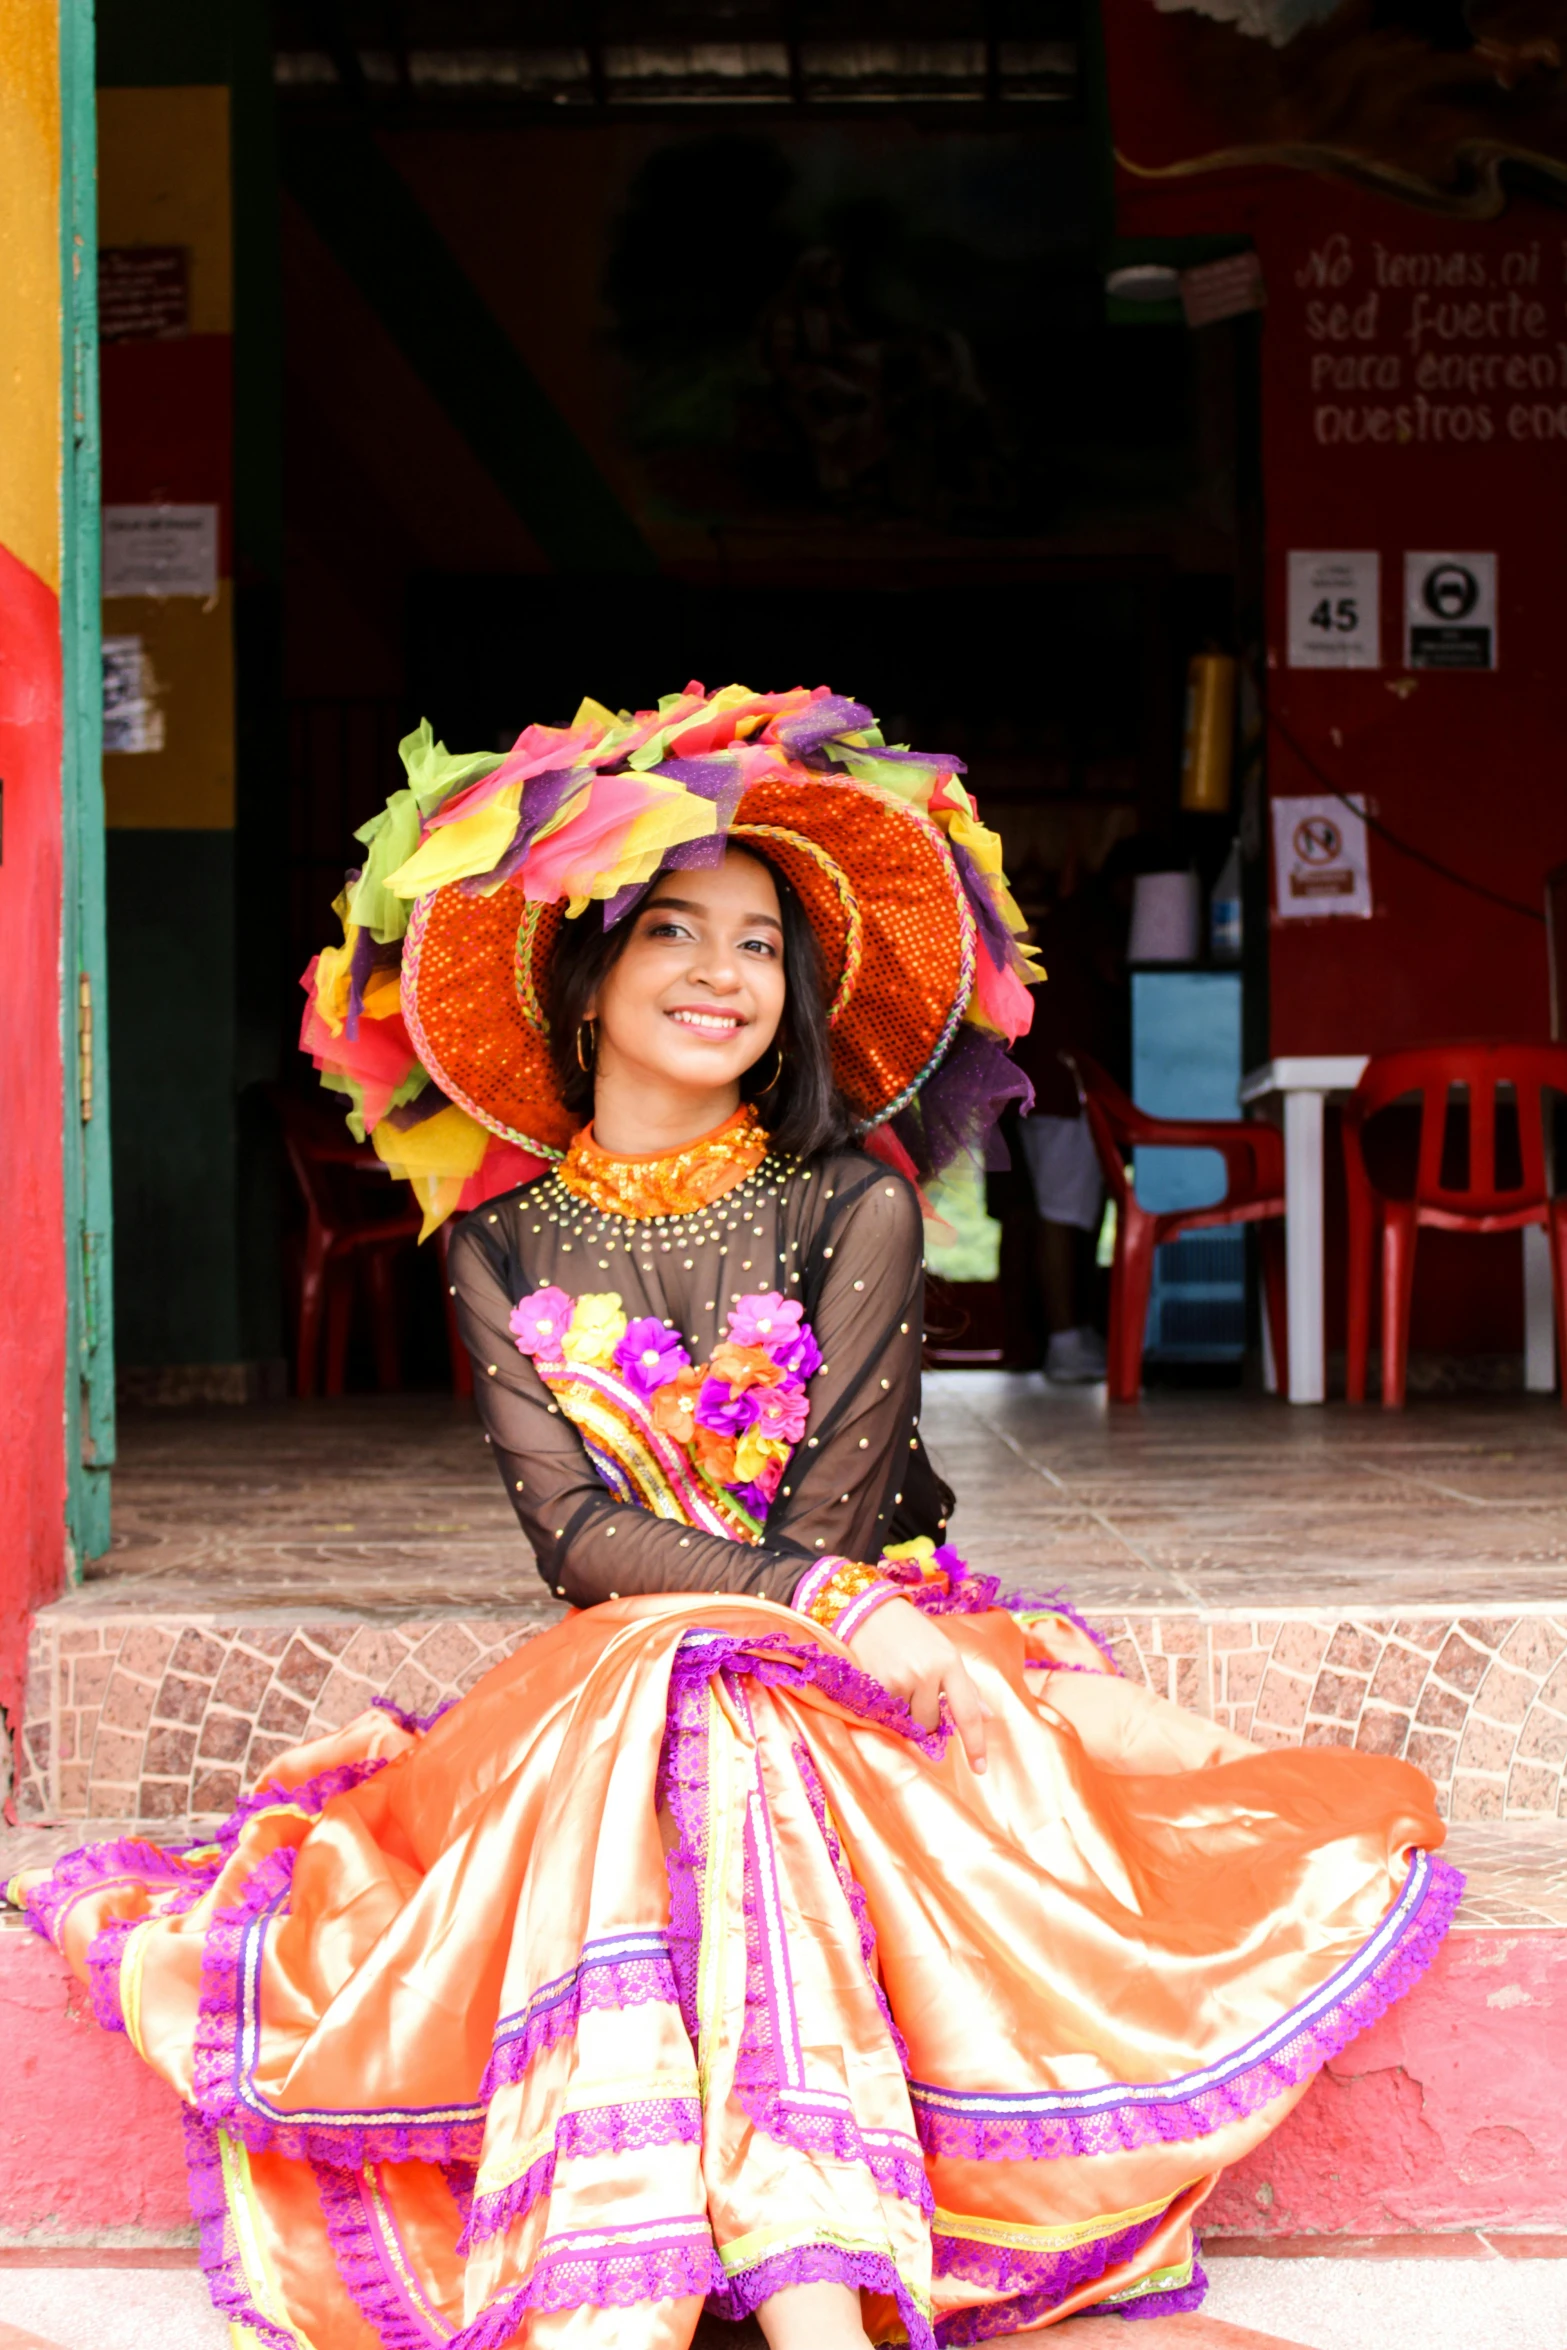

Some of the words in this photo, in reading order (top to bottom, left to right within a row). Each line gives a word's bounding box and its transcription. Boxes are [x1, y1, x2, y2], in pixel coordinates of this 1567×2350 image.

[1294, 232, 1354, 288] No
[1304, 288, 1379, 341] sed
[1402, 290, 1549, 357] fuerte
[1310, 351, 1402, 393] para
[1313, 391, 1495, 445] nuestros
[1309, 597, 1359, 633] 45
